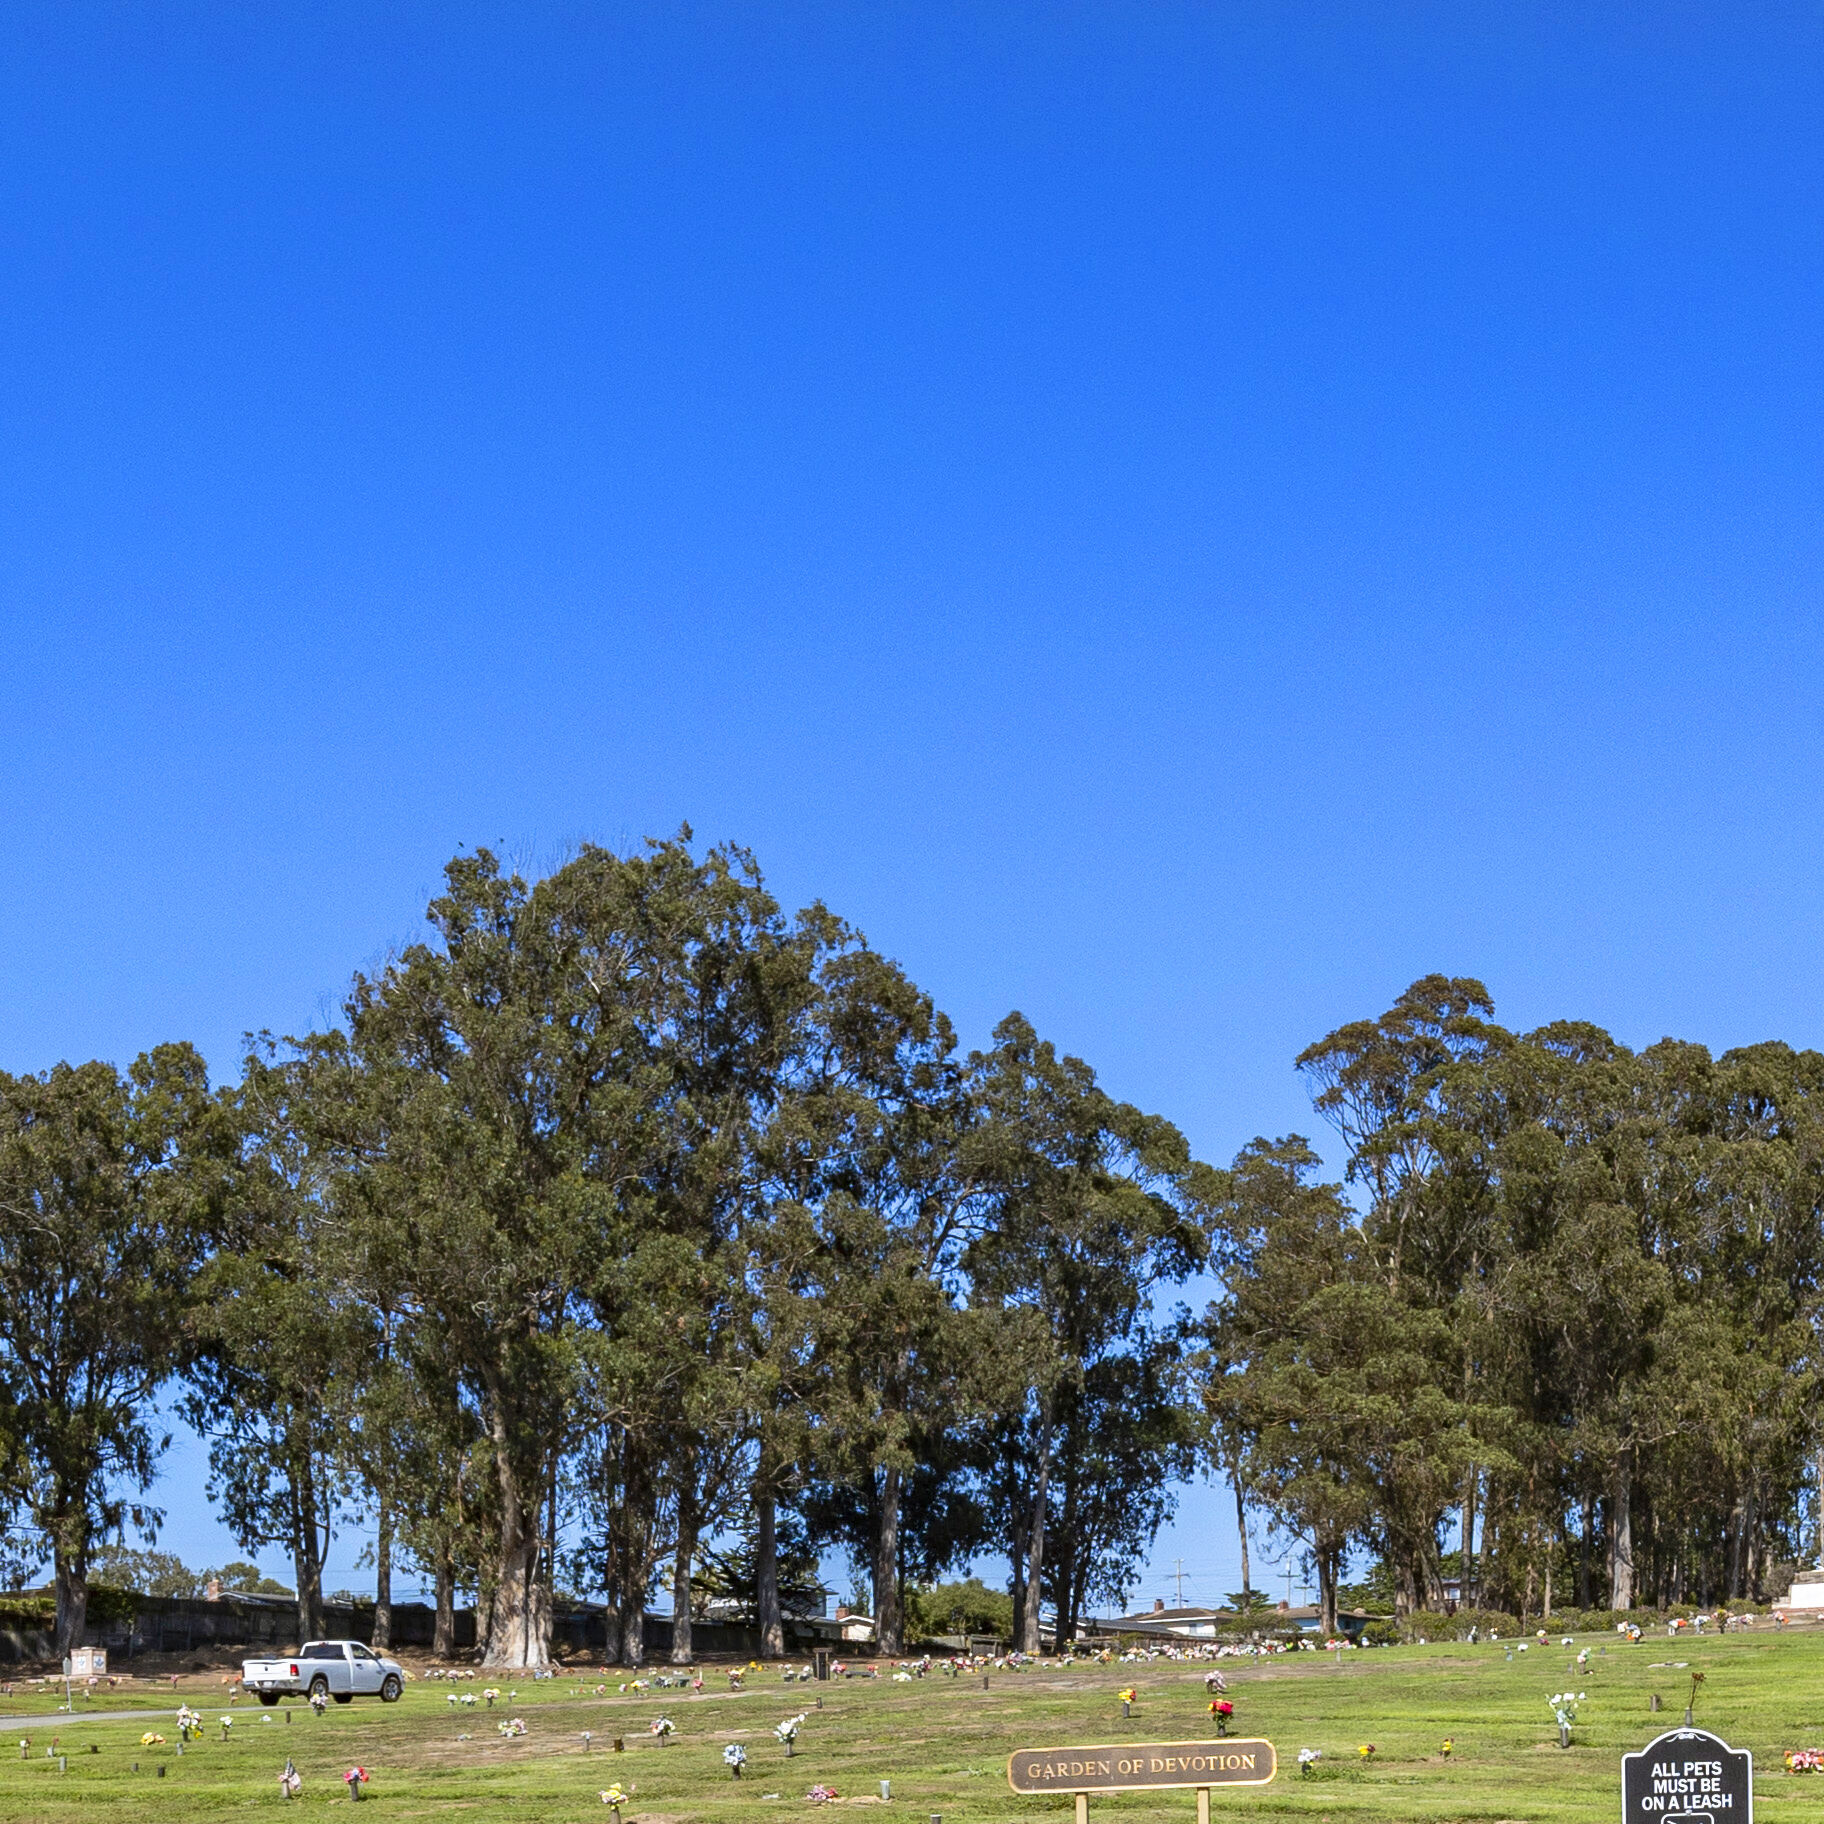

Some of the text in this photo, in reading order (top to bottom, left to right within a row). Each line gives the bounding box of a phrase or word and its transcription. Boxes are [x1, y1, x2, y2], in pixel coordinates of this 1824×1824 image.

[1027, 1754, 1256, 1779] GARDEN OF DEVOTION
[1651, 1761, 1723, 1778] ALL PETS
[1653, 1777, 1721, 1794] MUST BE
[1641, 1793, 1733, 1811] ON A LEASH
